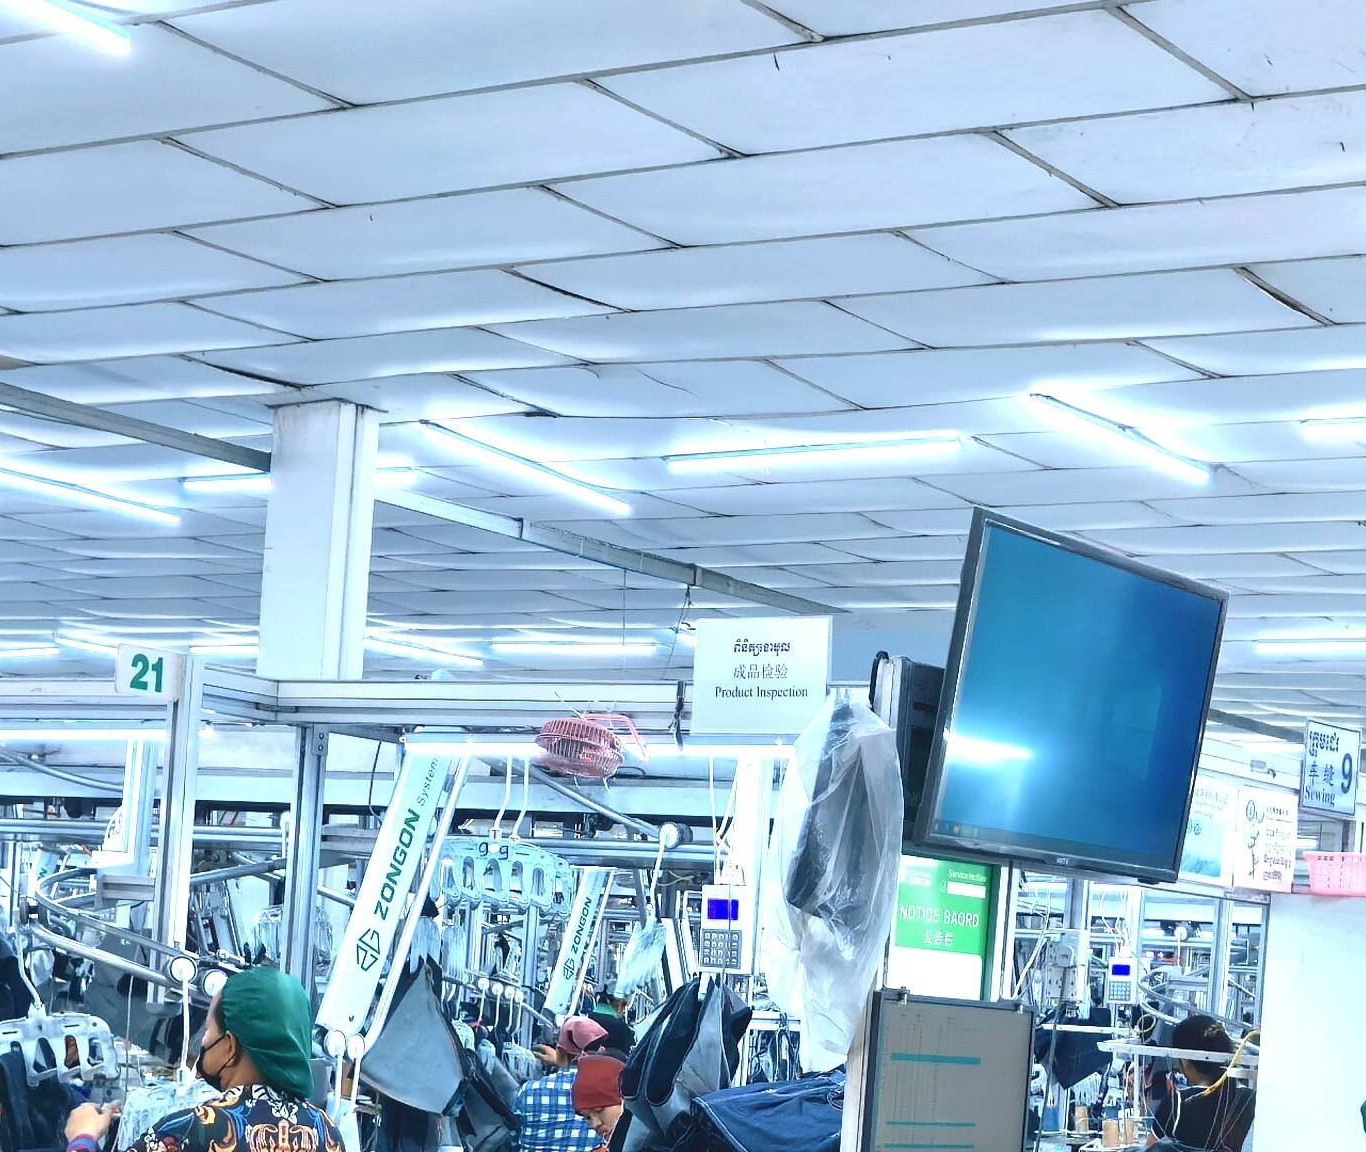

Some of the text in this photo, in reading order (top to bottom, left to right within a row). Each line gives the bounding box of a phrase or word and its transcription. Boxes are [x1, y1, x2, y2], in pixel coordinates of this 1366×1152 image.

[130, 653, 164, 693] 21
[715, 685, 808, 701] Product Inspection
[1341, 752, 1353, 794] 9
[1304, 785, 1335, 808] Sewing
[374, 807, 421, 921] ZONGON
[571, 896, 593, 955] ZONGON
[900, 904, 980, 928] NOTICE BAORD
